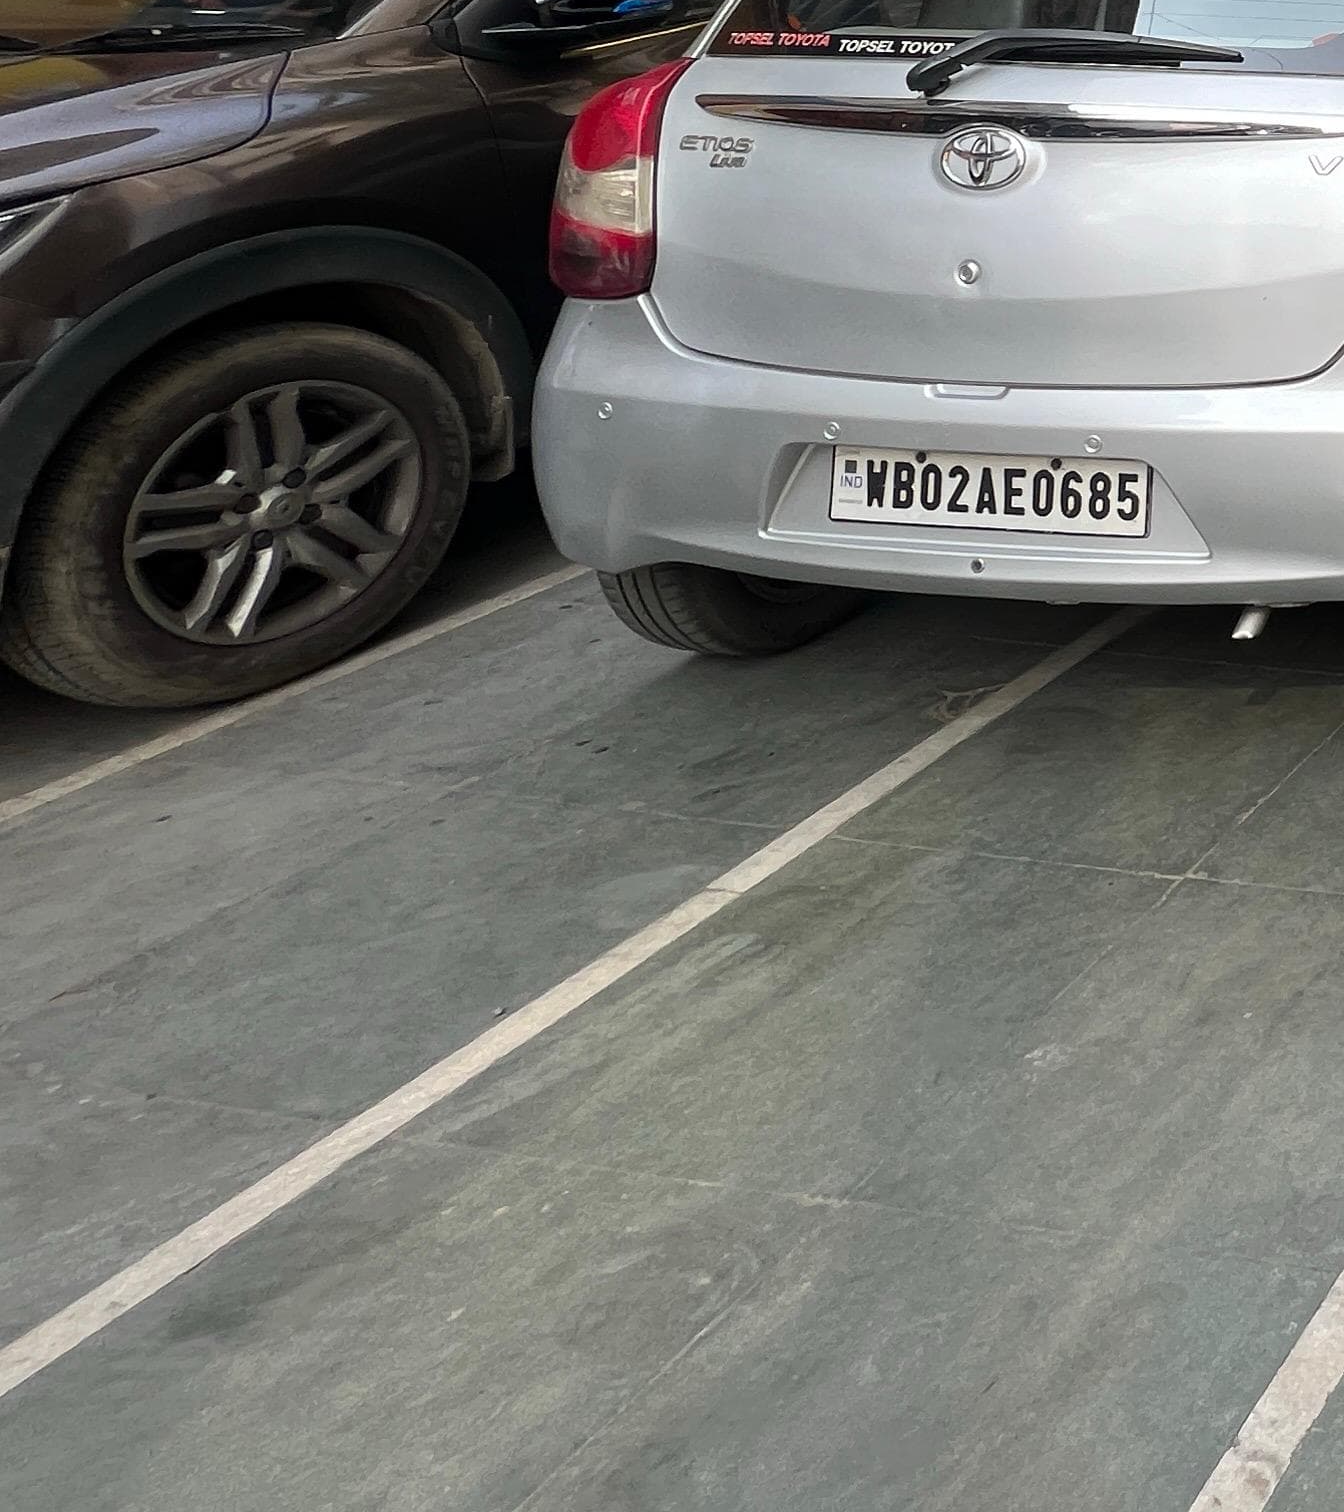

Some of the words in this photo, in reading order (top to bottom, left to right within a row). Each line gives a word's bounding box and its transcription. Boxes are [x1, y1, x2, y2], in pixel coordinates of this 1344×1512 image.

[728, 32, 774, 46] TOPSEL
[777, 33, 830, 47] TOYOTA
[838, 39, 896, 53] TOPSEL
[679, 135, 755, 154] ETIOS
[840, 475, 863, 488] IND
[866, 460, 1140, 521] WB02AE0685
